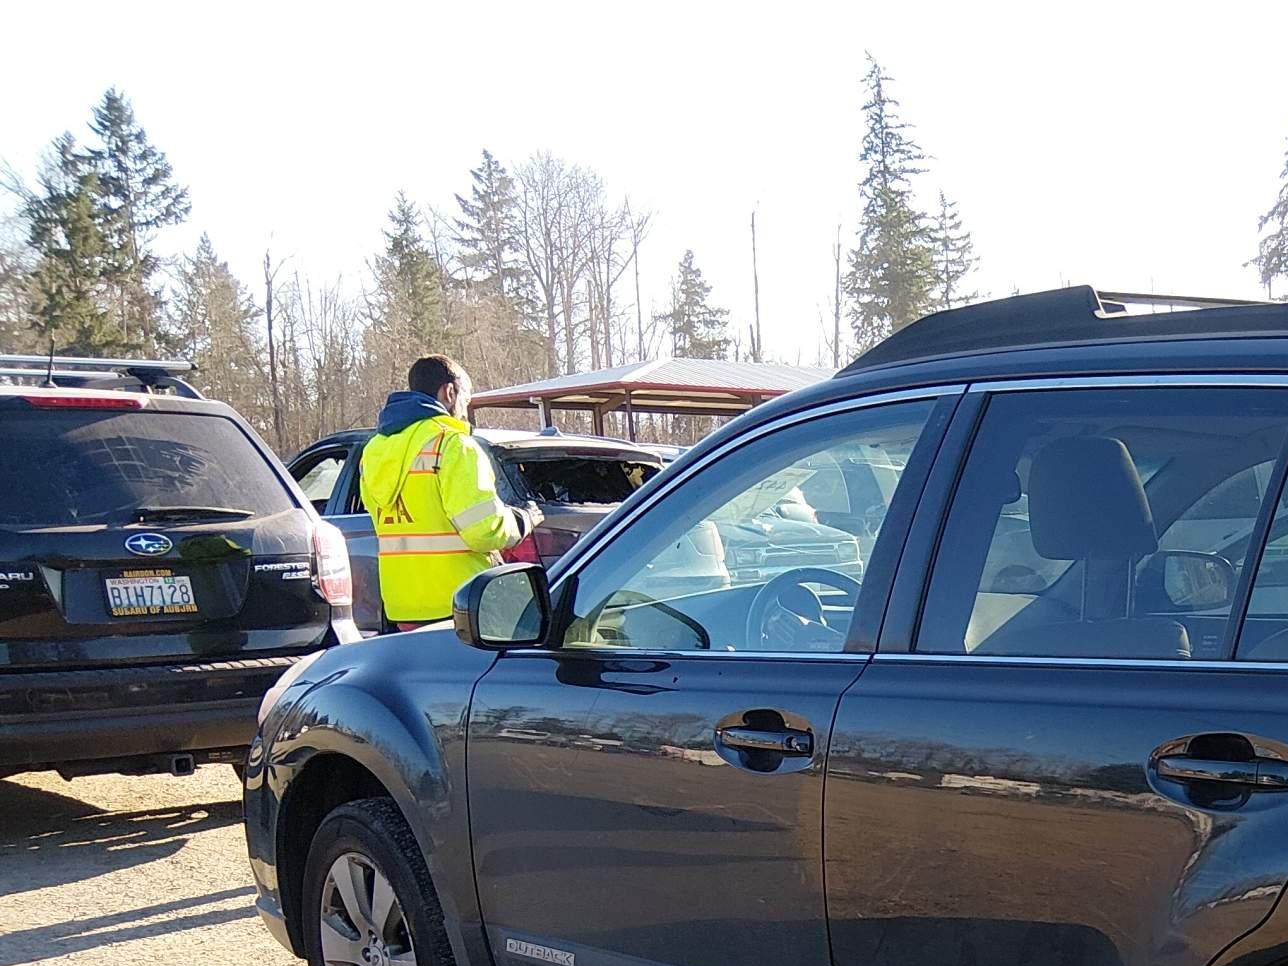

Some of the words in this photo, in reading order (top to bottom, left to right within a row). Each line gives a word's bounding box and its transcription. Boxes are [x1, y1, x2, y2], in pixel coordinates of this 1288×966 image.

[254, 562, 310, 572] FORESTER
[110, 584, 191, 608] BIH7128
[149, 605, 161, 614] OF
